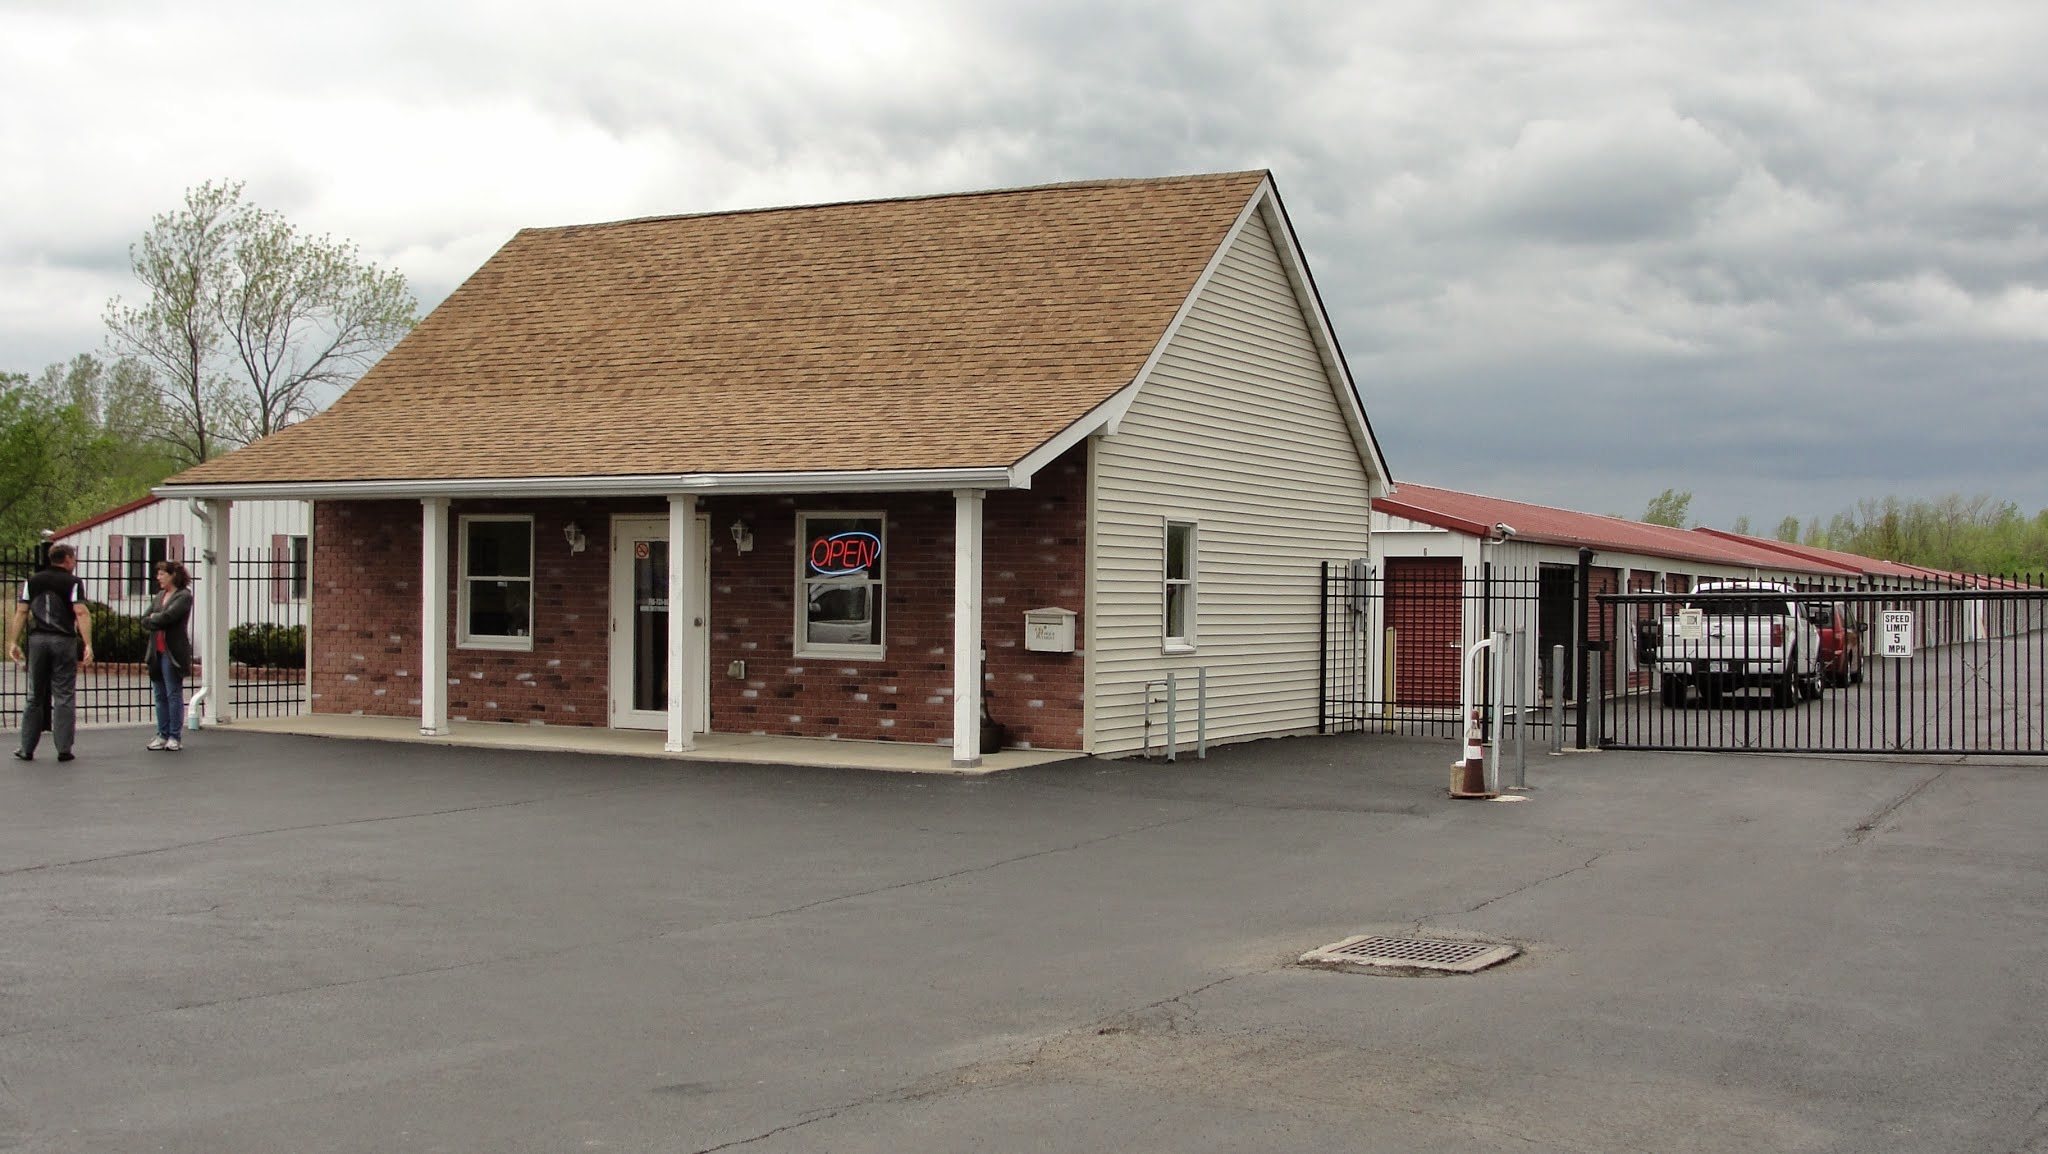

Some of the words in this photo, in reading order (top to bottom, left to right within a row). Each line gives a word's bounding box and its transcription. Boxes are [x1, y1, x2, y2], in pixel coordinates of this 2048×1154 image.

[812, 539, 875, 567] OPEN
[1885, 615, 1910, 623] SPEED
[1886, 624, 1908, 632] LIMIT
[1894, 633, 1900, 644] 5
[1888, 645, 1906, 653] MPH
